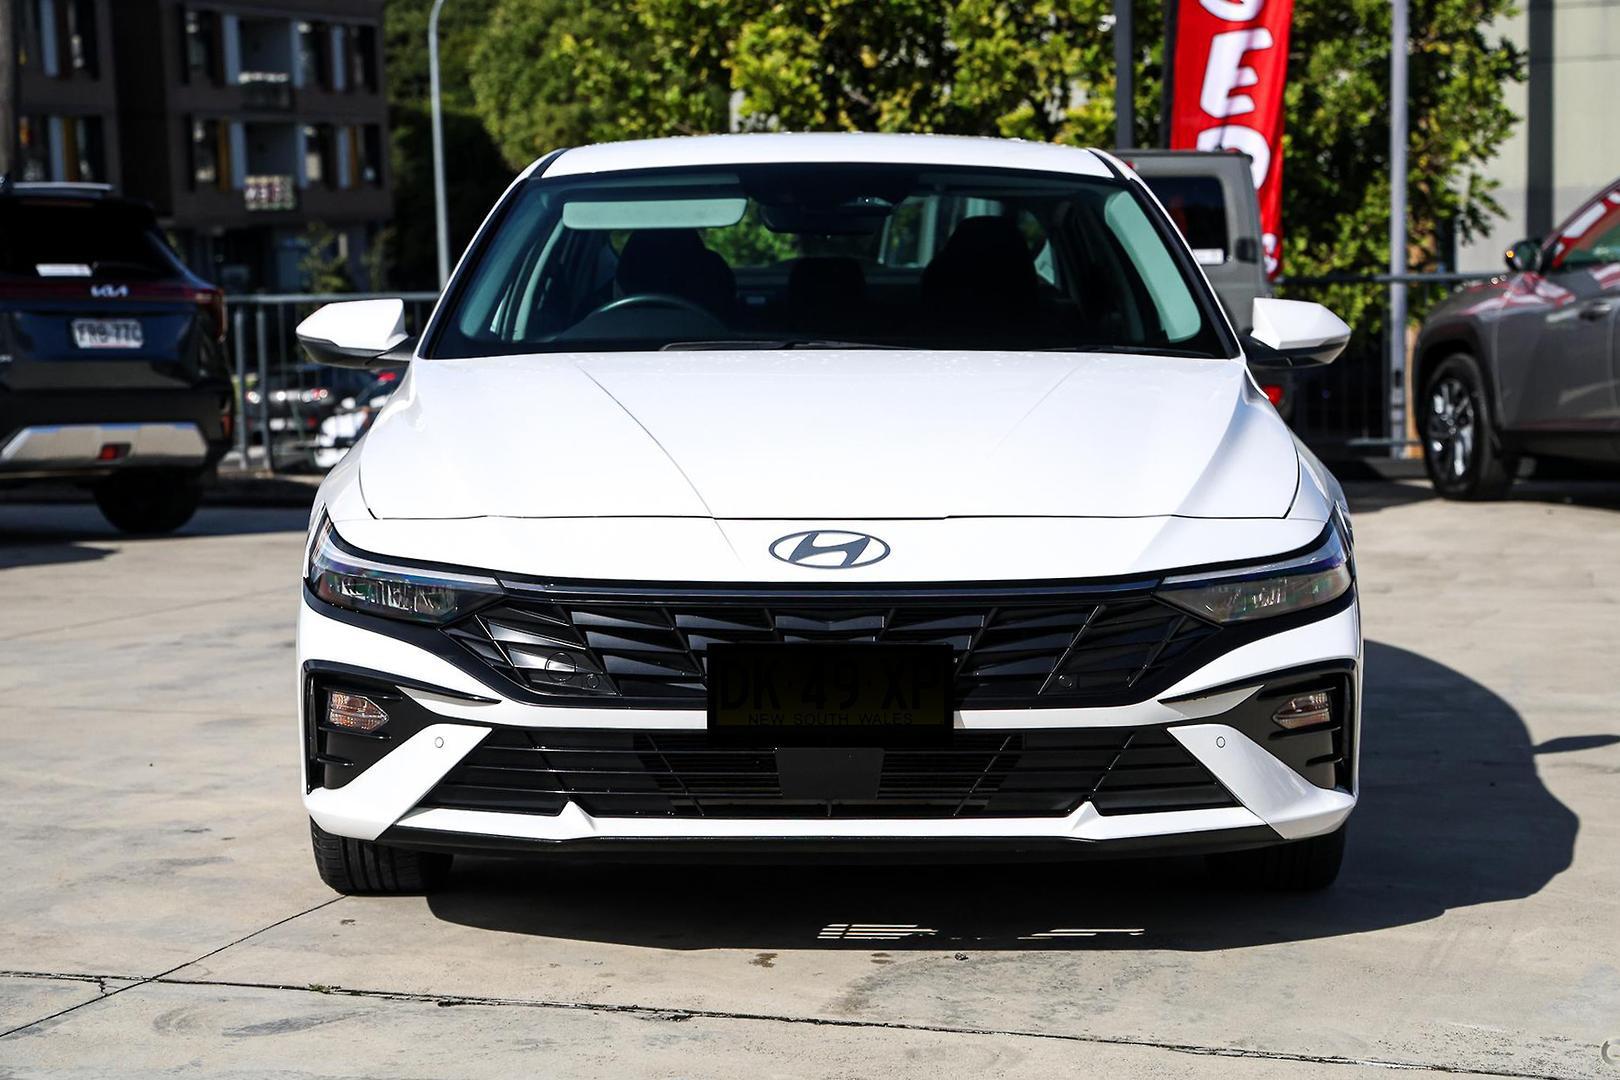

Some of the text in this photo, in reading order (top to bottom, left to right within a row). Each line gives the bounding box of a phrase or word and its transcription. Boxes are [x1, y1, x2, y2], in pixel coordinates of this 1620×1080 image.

[800, 657, 859, 709] 49
[748, 712, 913, 726] NEW SOUTH WALES
